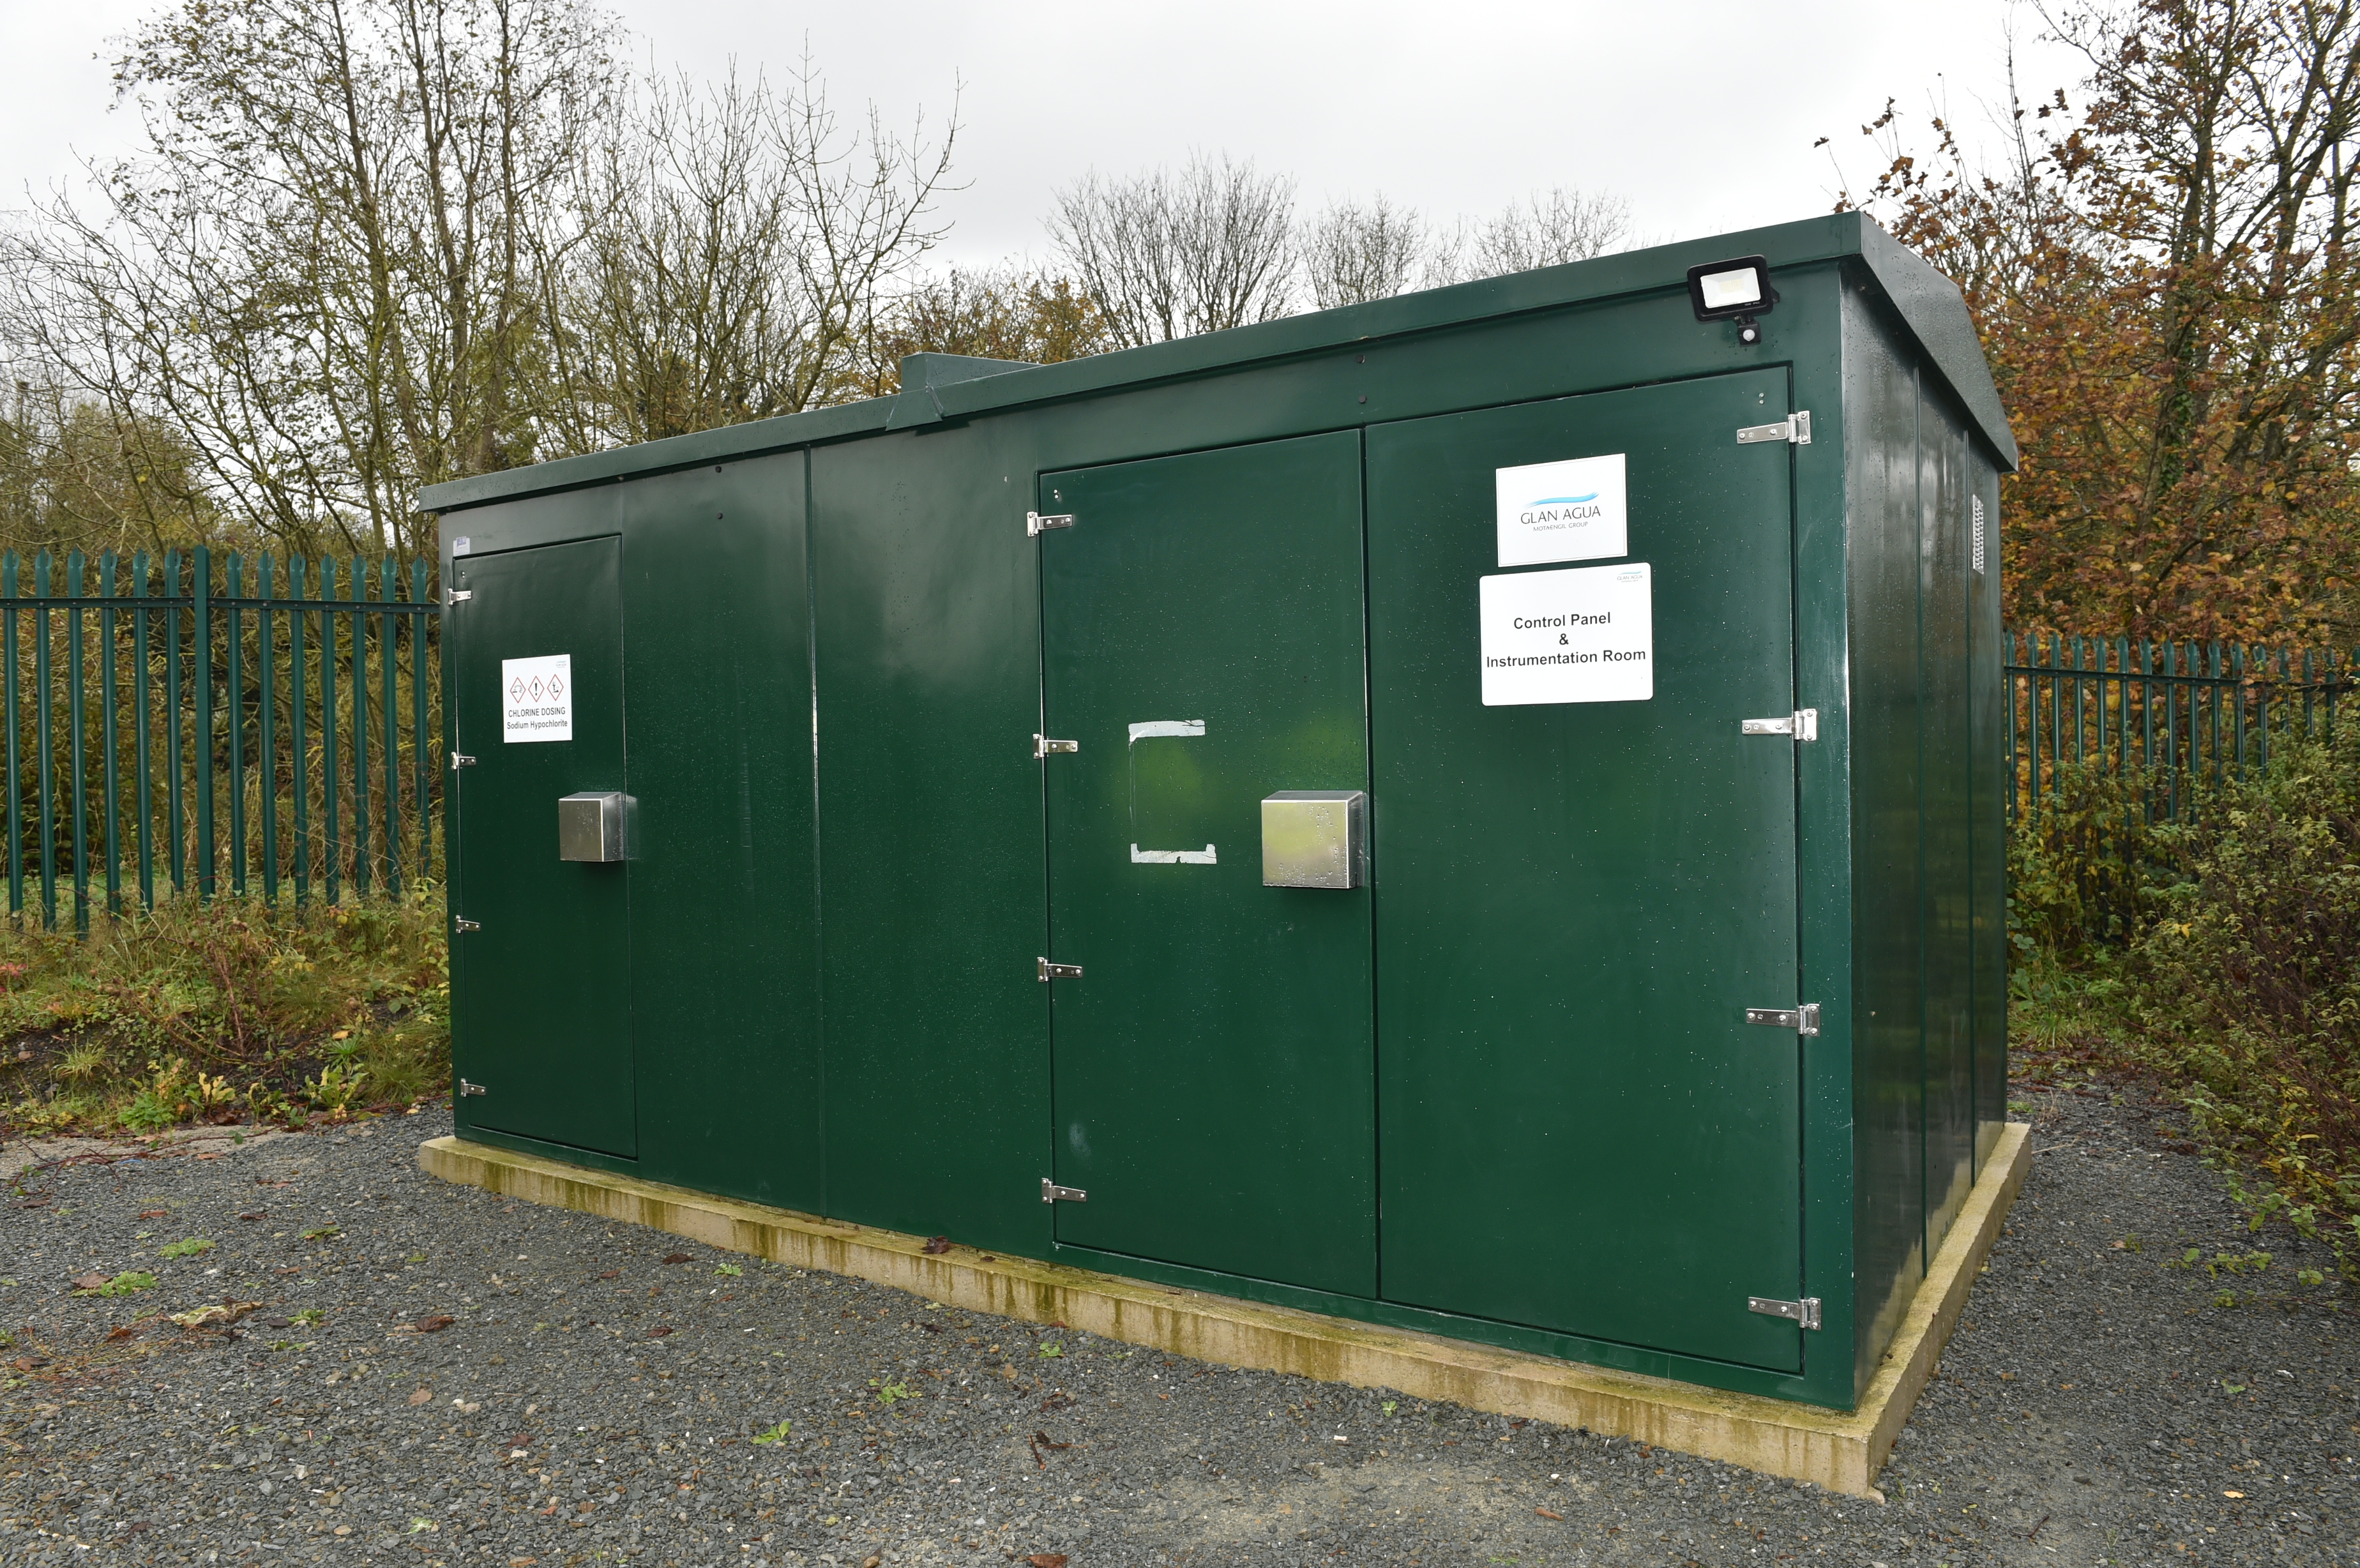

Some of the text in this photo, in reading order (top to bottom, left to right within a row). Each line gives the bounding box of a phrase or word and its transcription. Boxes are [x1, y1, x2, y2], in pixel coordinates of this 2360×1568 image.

[1520, 505, 1601, 524] GLAN AGUA
[1513, 612, 1611, 629] Control Panel
[1559, 633, 1569, 645] &
[1486, 649, 1646, 668] Instrumentation Room
[508, 707, 566, 718] CHLORINE DOSING
[507, 719, 568, 730] Sodium Hypochlorite
